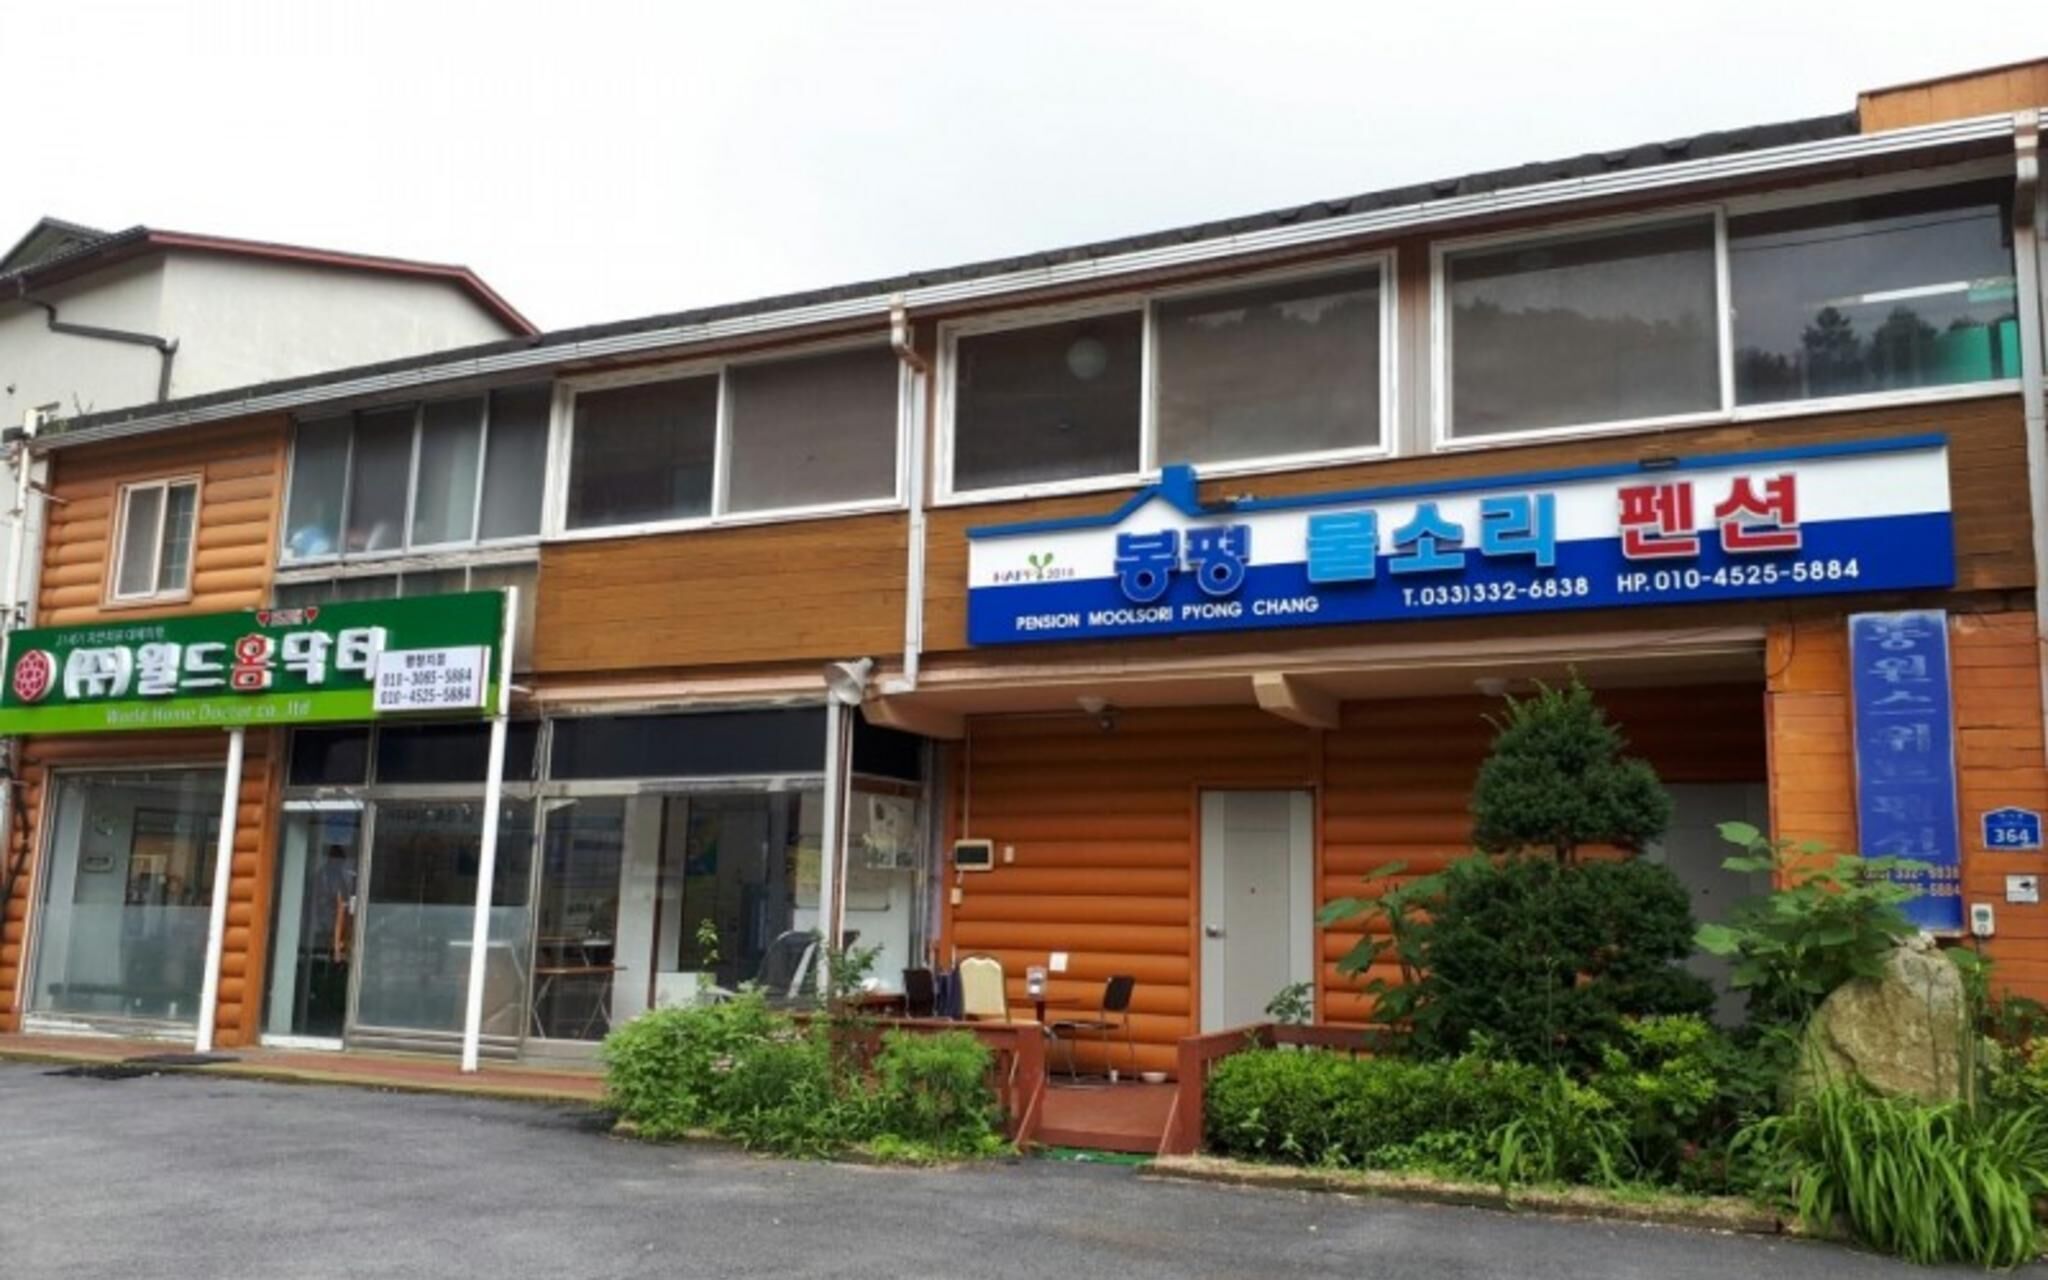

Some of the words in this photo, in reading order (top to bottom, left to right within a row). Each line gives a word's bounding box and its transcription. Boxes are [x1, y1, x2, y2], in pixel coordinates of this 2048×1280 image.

[1113, 524, 1252, 602] 봉평
[1307, 491, 1557, 583] 물소리
[1616, 472, 1802, 561] 펜션
[1015, 612, 1080, 631] PENSION
[1089, 605, 1174, 626] MOOLSORI
[1182, 599, 1243, 620] PYONG
[1253, 595, 1320, 616] CHANG
[152, 706, 196, 723] Home
[1993, 828, 2030, 843] 364
